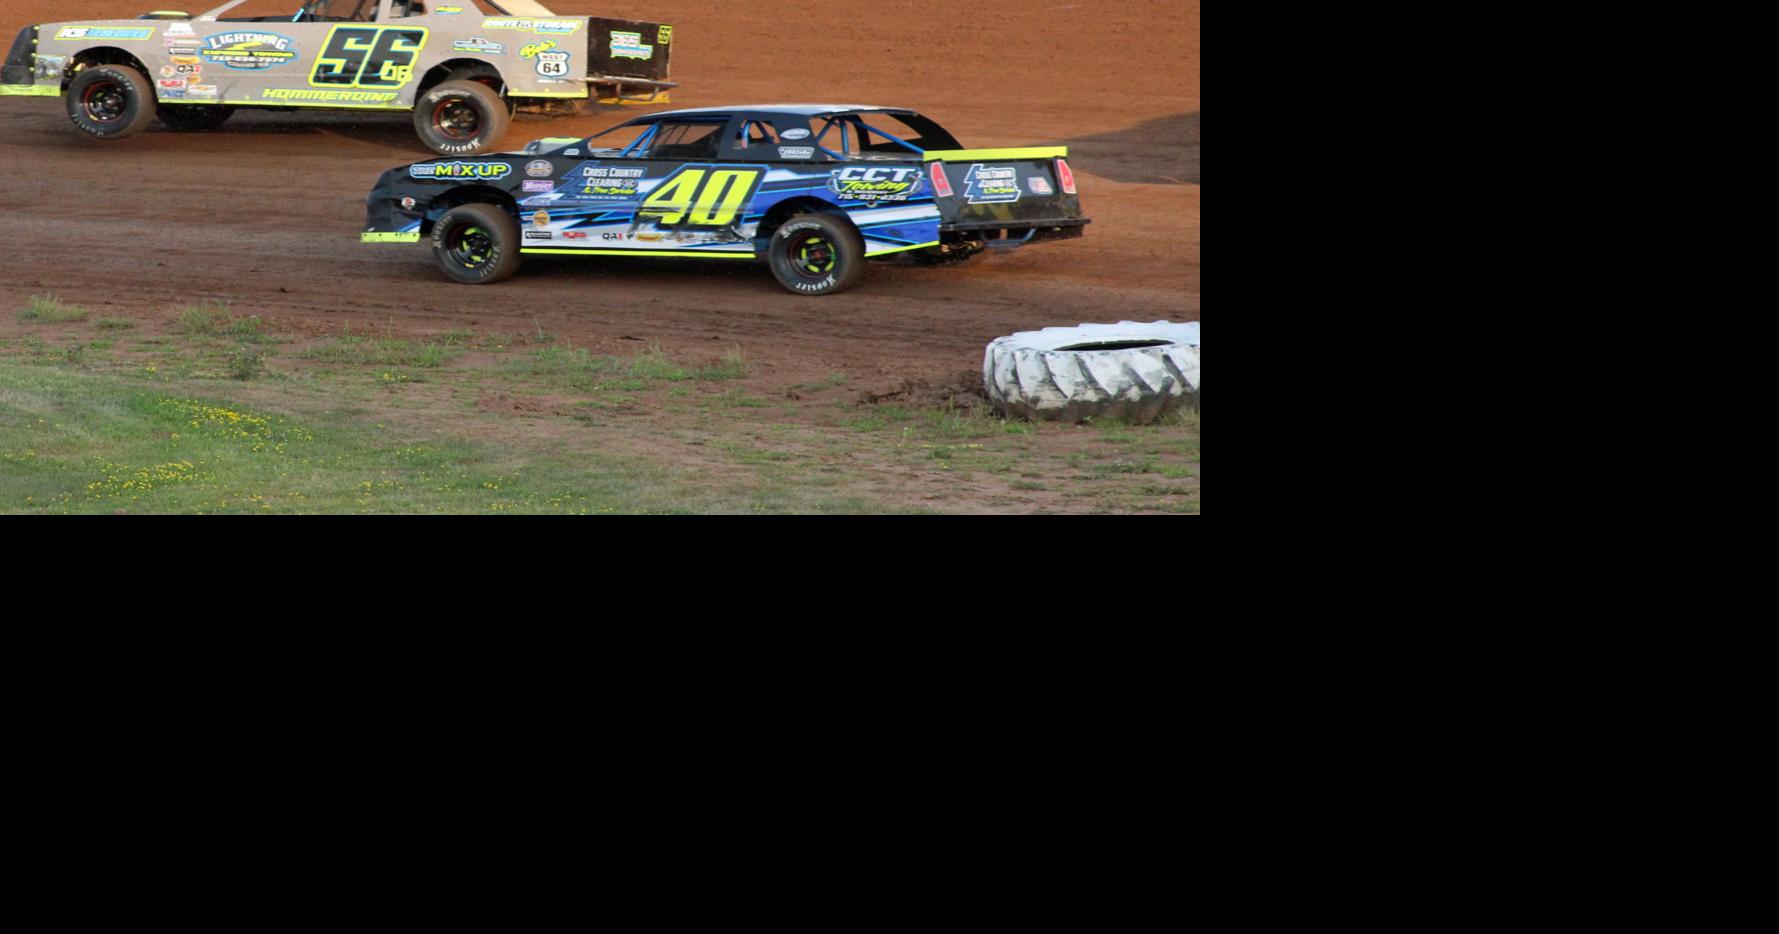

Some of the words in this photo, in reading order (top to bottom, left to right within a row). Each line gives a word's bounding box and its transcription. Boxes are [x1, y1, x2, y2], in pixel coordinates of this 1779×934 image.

[208, 33, 290, 50] LIGHTNING
[310, 26, 427, 88] 56
[542, 62, 561, 74] 64
[478, 164, 507, 177] UP
[582, 167, 609, 177] CROSS
[609, 167, 644, 178] COUNTRY
[838, 167, 916, 182] CCT
[841, 180, 911, 193] Towing
[639, 168, 759, 226] 40
